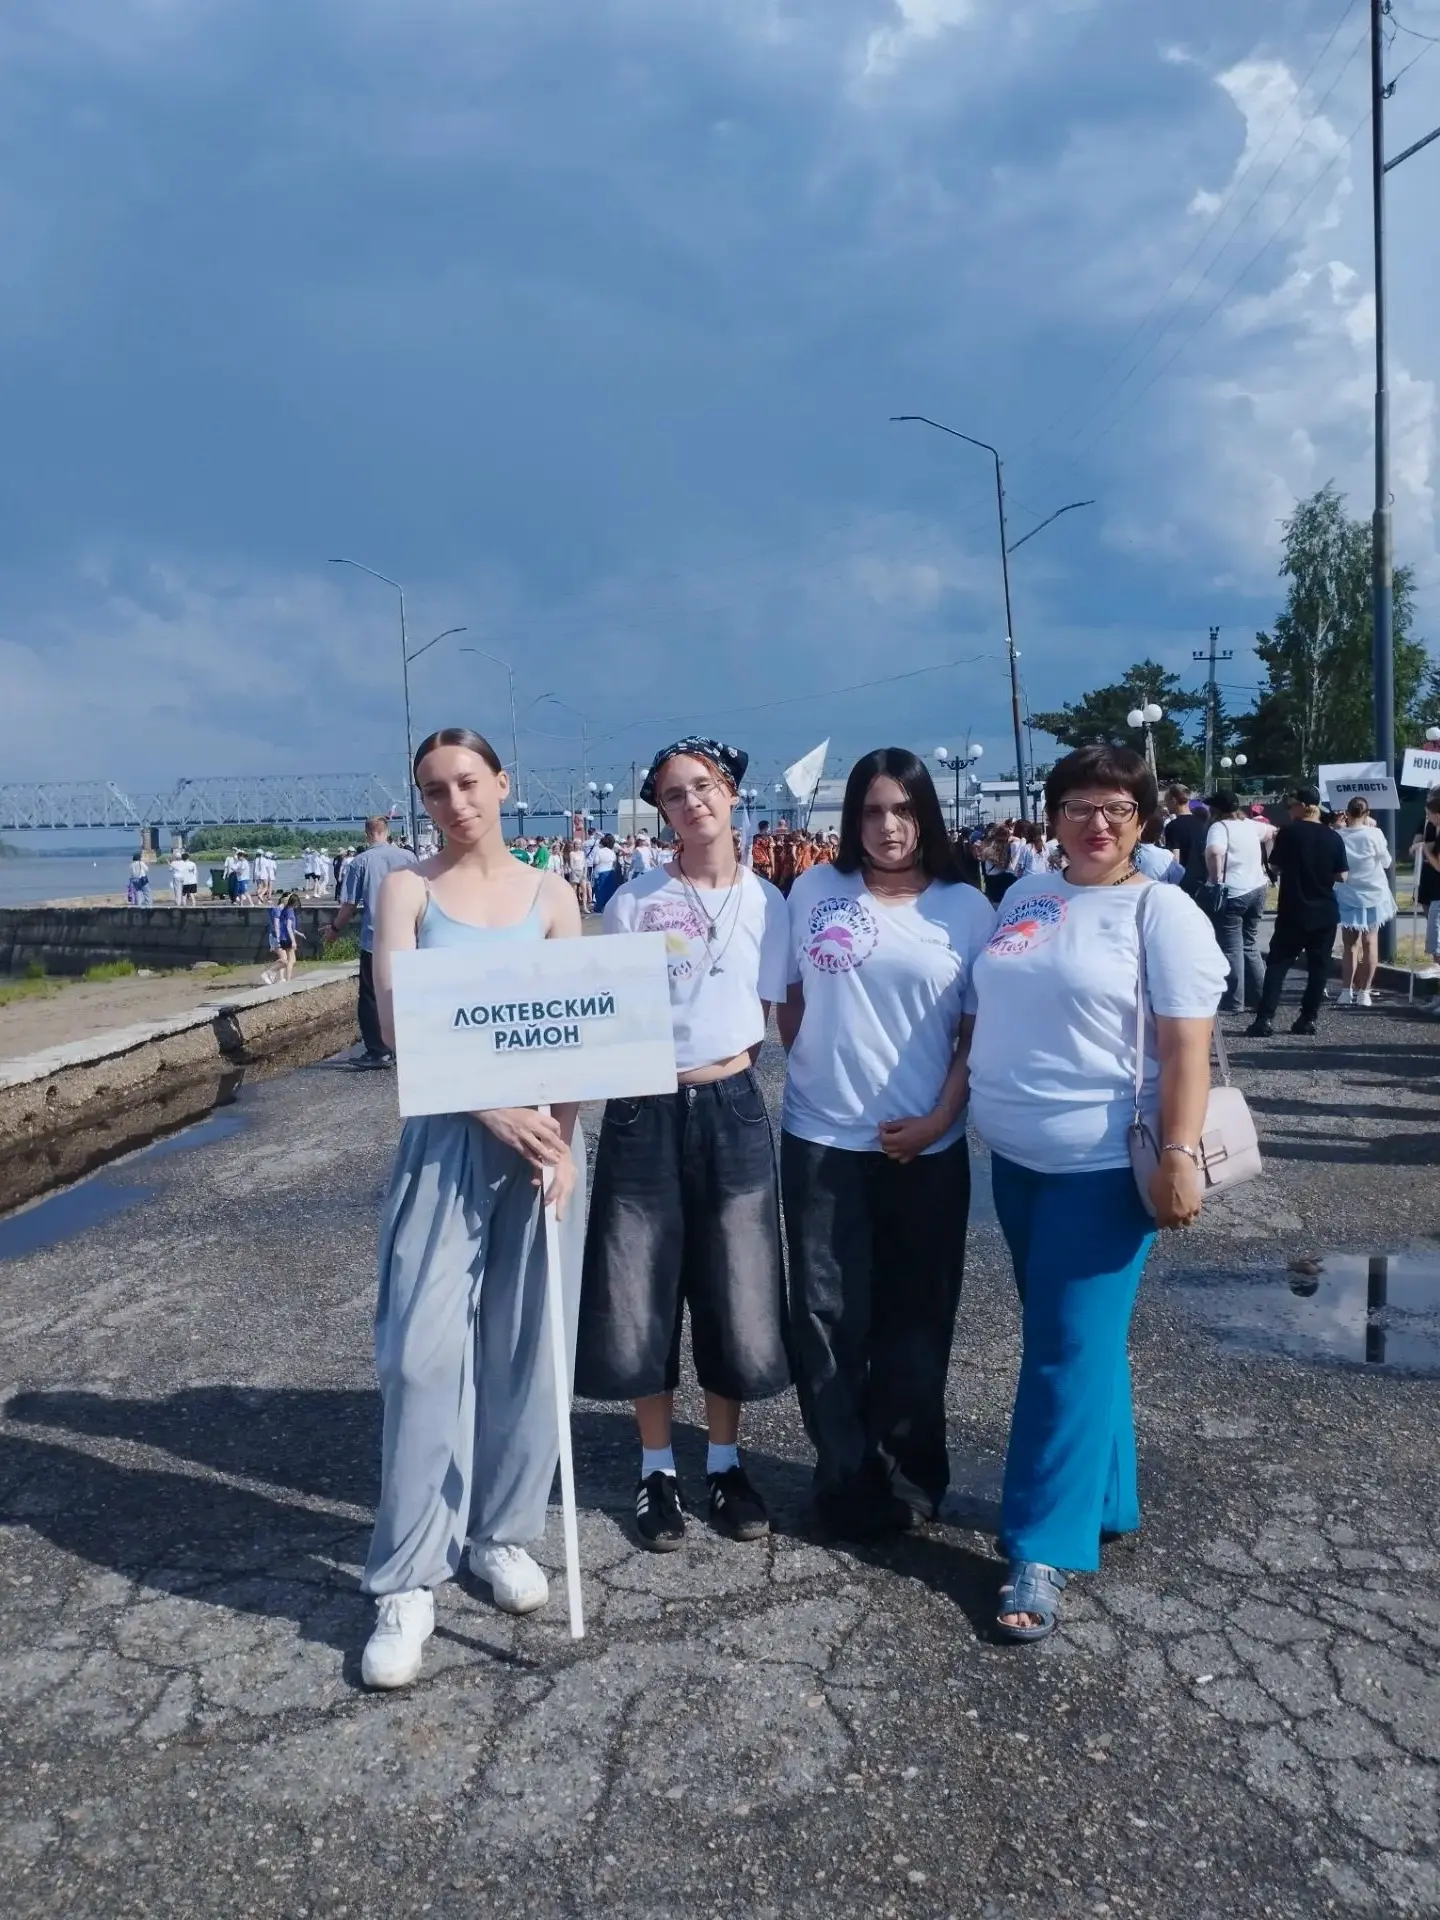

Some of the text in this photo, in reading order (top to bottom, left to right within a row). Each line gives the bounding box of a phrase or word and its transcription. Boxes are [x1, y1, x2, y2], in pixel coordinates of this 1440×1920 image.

[1413, 757, 1440, 769] ЮНО
[1336, 783, 1388, 792] СМЕЛОСТЬ
[454, 991, 615, 1026] ЛОКТЕВСКИЙ
[495, 1024, 579, 1049] РАЙОН
